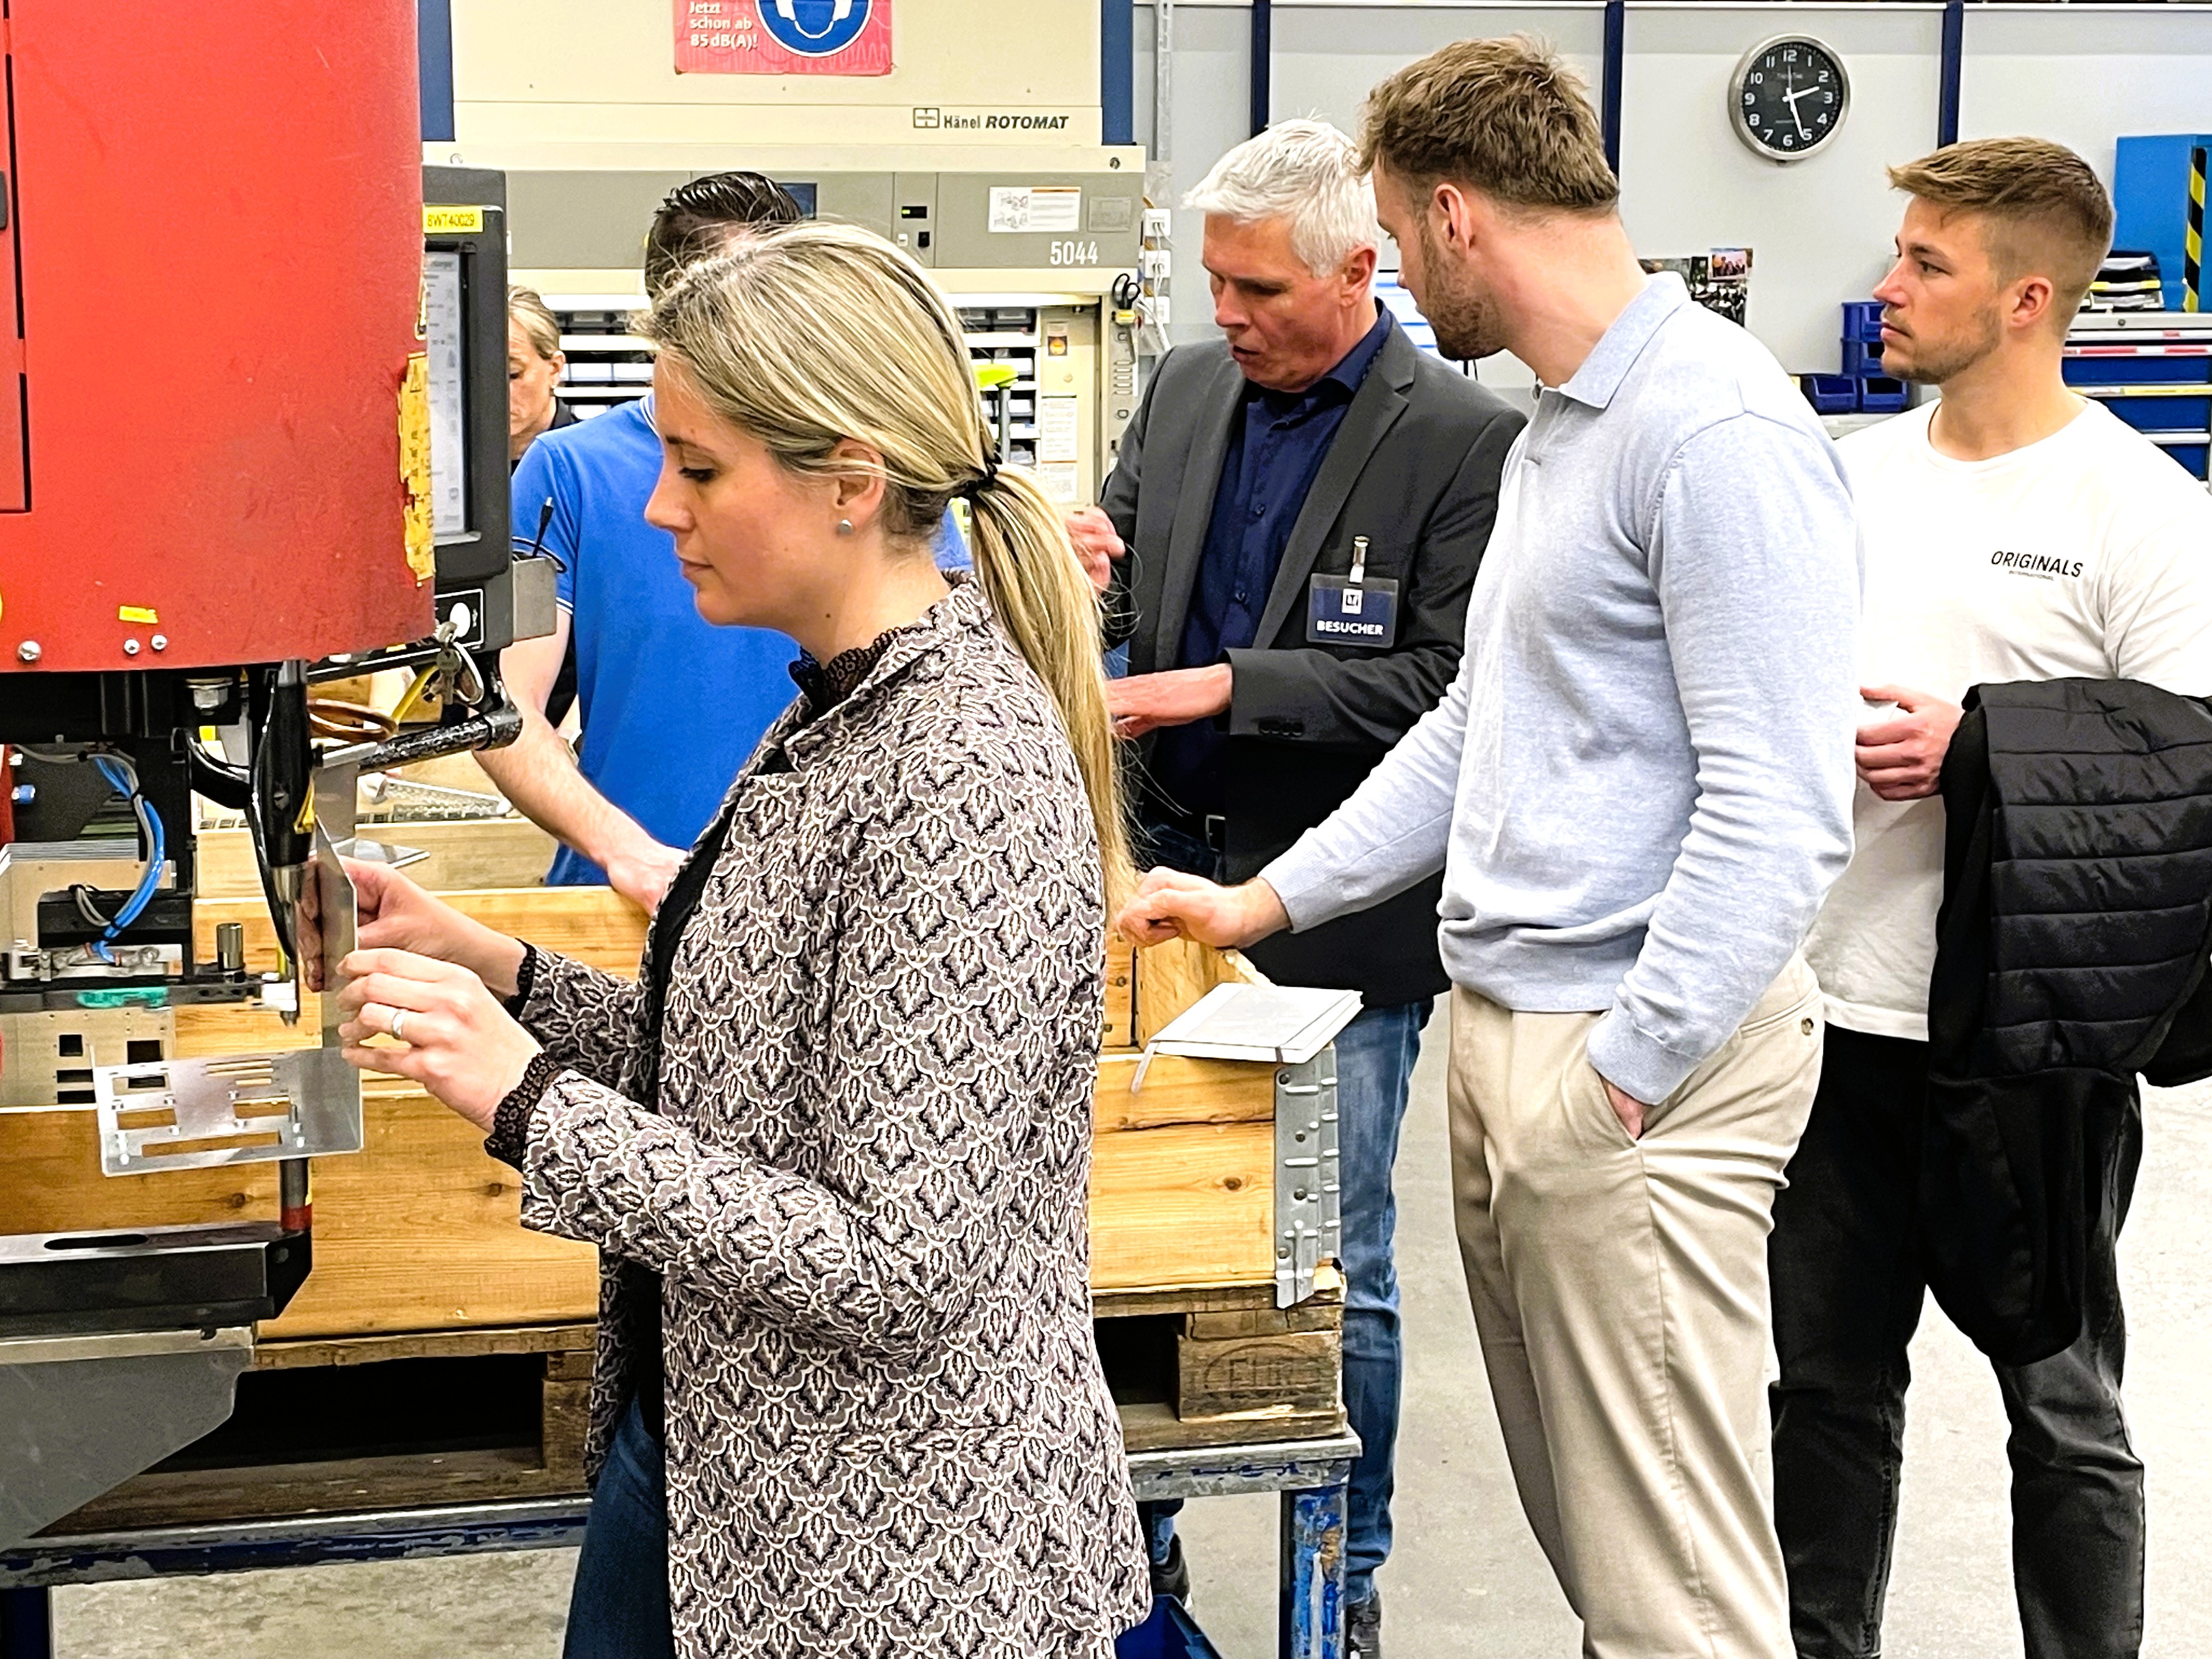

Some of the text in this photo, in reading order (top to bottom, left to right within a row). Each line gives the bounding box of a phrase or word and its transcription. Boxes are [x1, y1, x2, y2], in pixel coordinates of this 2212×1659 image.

[689, 1, 721, 14] Jetzt
[690, 16, 753, 30] schon ab
[690, 33, 758, 51] 85 dB(A)!
[1765, 55, 1775, 68] 11
[1783, 49, 1798, 62] 12
[1807, 55, 1812, 67] 1
[1750, 72, 1764, 85] 10
[1818, 70, 1829, 83] 2
[1744, 93, 1755, 105] 9
[1823, 91, 1833, 105] 3
[944, 114, 1069, 129] Hänel ROTOMAT
[1749, 113, 1760, 126] 8
[1817, 113, 1828, 125] 4
[1763, 129, 1773, 141] 7
[1782, 134, 1793, 147] 6
[1803, 128, 1813, 141] 5
[1049, 241, 1099, 265] 5044
[1991, 551, 2084, 578] ORIGINALS
[1316, 620, 1384, 635] BESUCHER
